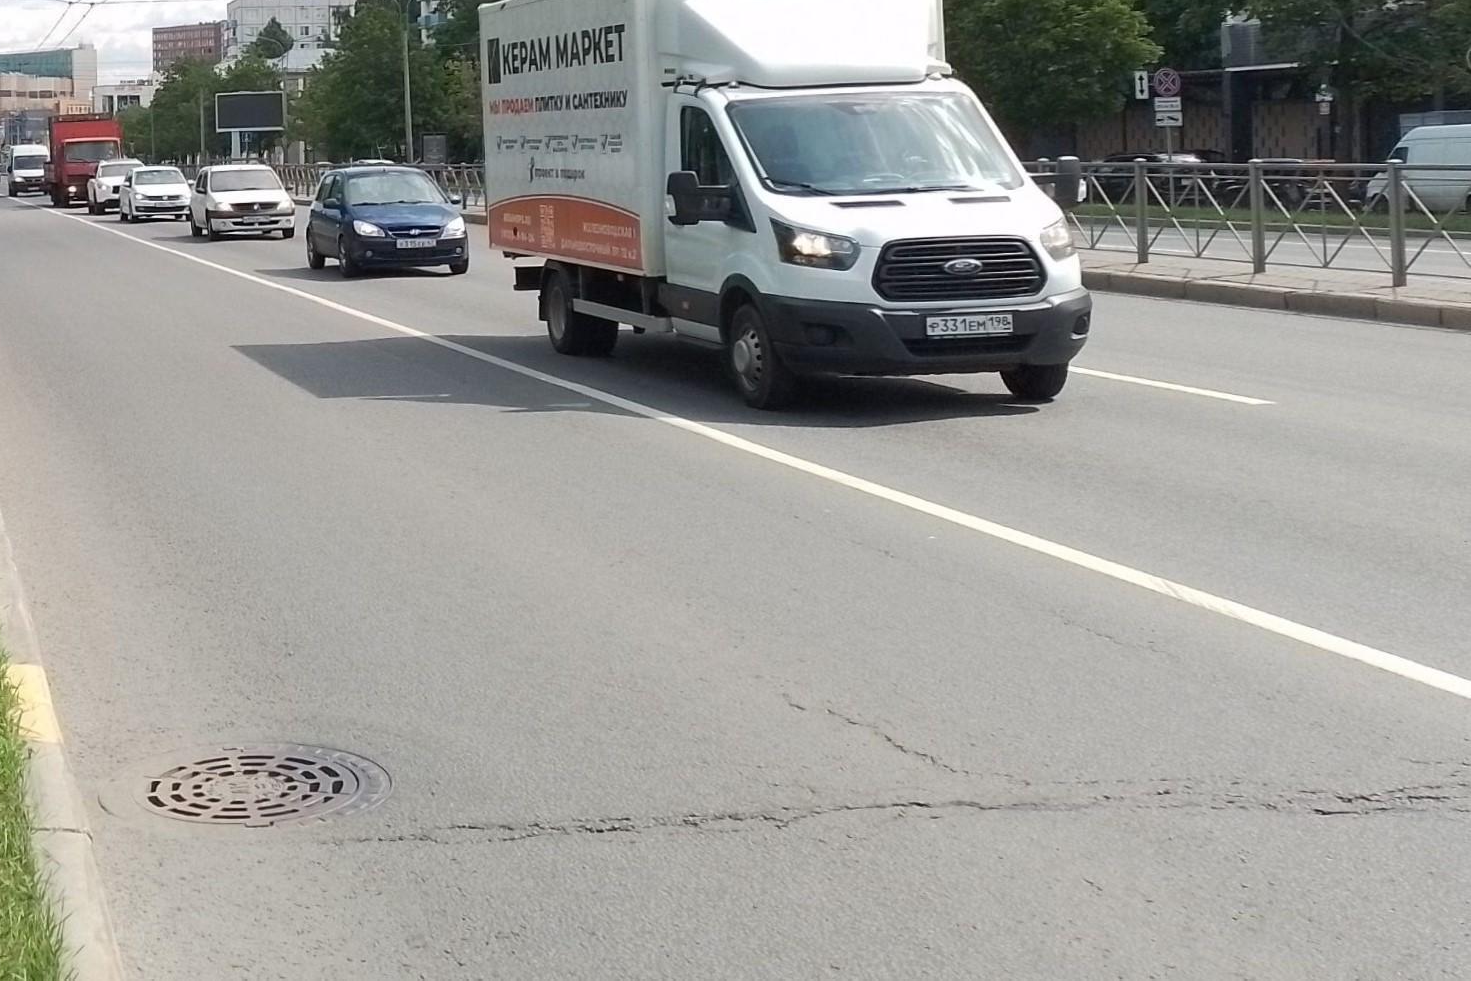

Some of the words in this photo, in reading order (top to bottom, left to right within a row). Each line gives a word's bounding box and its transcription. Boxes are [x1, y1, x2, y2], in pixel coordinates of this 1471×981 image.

[502, 36, 551, 75] КЕРАМ
[555, 24, 625, 69] МАРКЕТ
[489, 99, 501, 115] МЫ
[501, 97, 535, 115] ПРОДАЕМ
[535, 94, 563, 113] ПЛИТКУ
[565, 95, 571, 110] И
[572, 89, 628, 110] САНТЕХНИКУ
